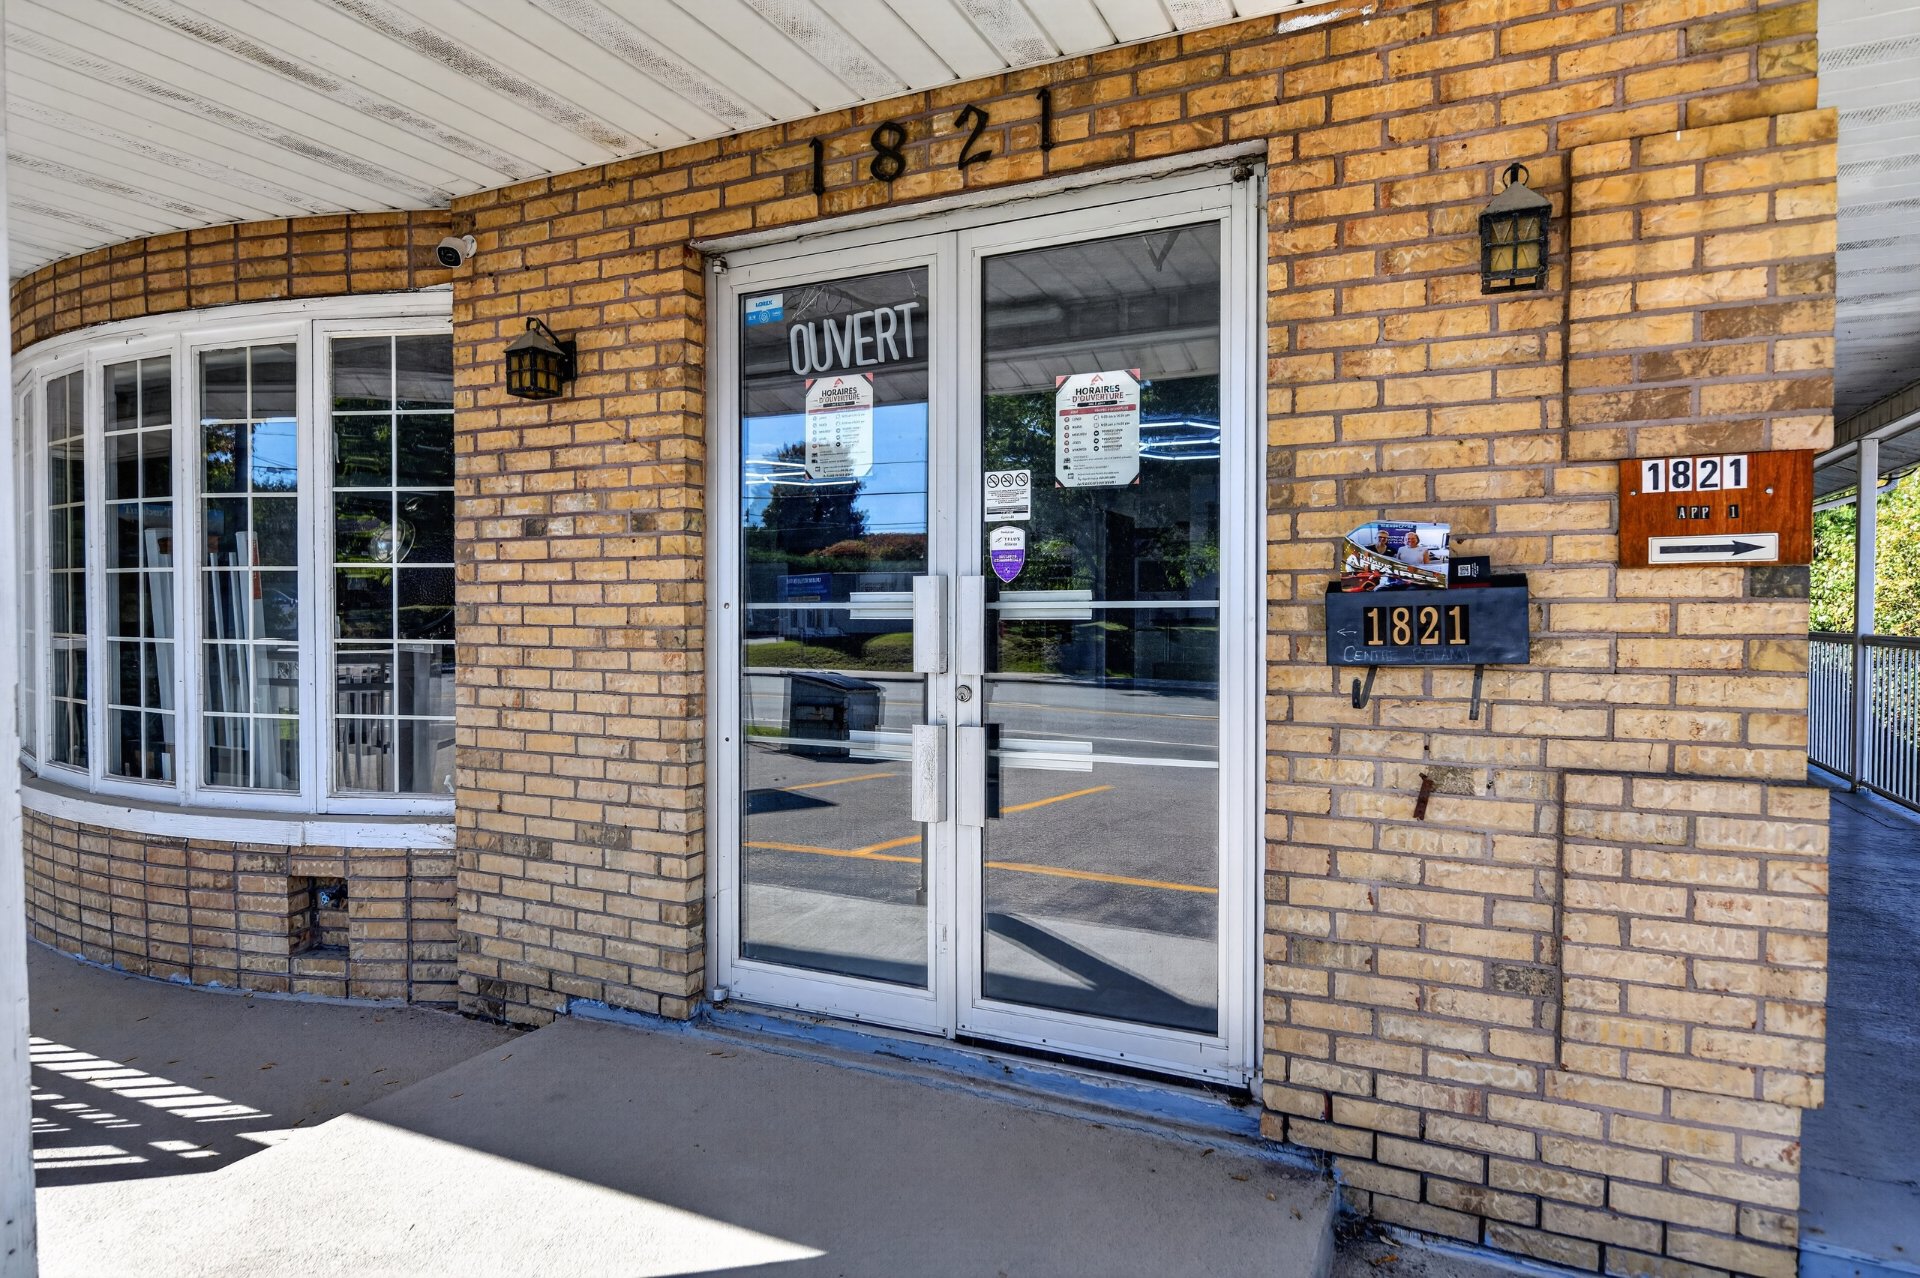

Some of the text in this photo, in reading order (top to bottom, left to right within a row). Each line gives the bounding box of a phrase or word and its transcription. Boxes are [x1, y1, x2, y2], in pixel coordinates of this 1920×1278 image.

[808, 88, 1054, 196] 1821
[789, 301, 920, 376] OUVERT
[819, 393, 860, 403] D'OUVERTURE
[821, 387, 858, 397] HORAIRES
[1072, 391, 1124, 403] D'OUVERTURE
[1075, 384, 1120, 396] HORAIRES
[1648, 458, 1741, 491] 1821
[1678, 506, 1709, 519] APP
[1346, 554, 1439, 583] AFFAIRES
[1367, 605, 1467, 646] 1821
